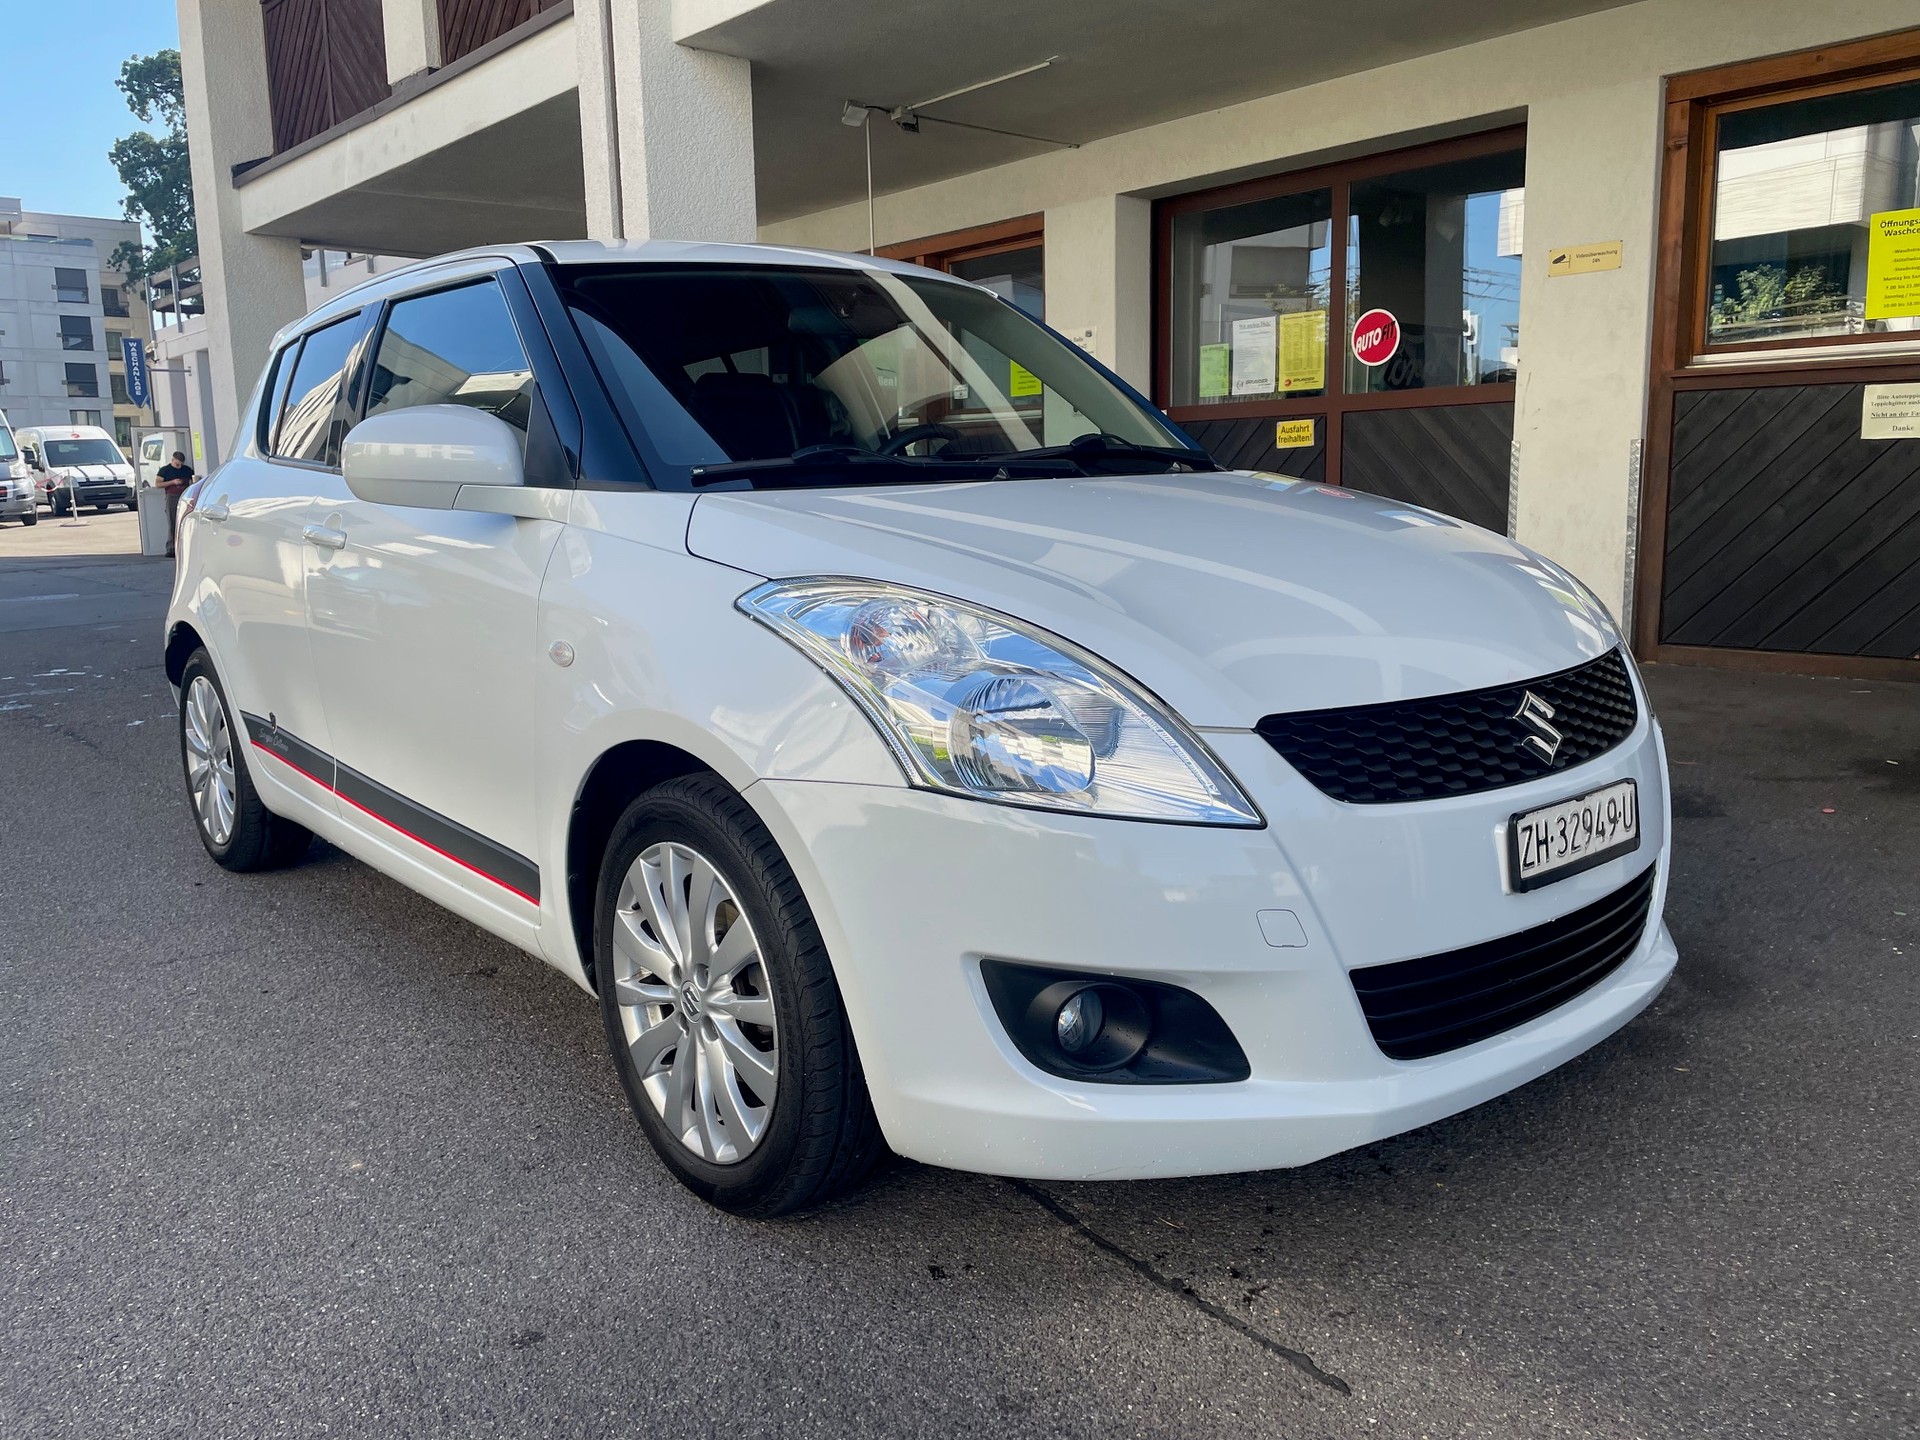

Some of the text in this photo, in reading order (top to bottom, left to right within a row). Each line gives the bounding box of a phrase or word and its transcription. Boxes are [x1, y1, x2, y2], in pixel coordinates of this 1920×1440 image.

[128, 342, 141, 395] WASCHANLAGE
[1281, 424, 1310, 434] Ausfahrt
[1278, 433, 1312, 444] freihalten!
